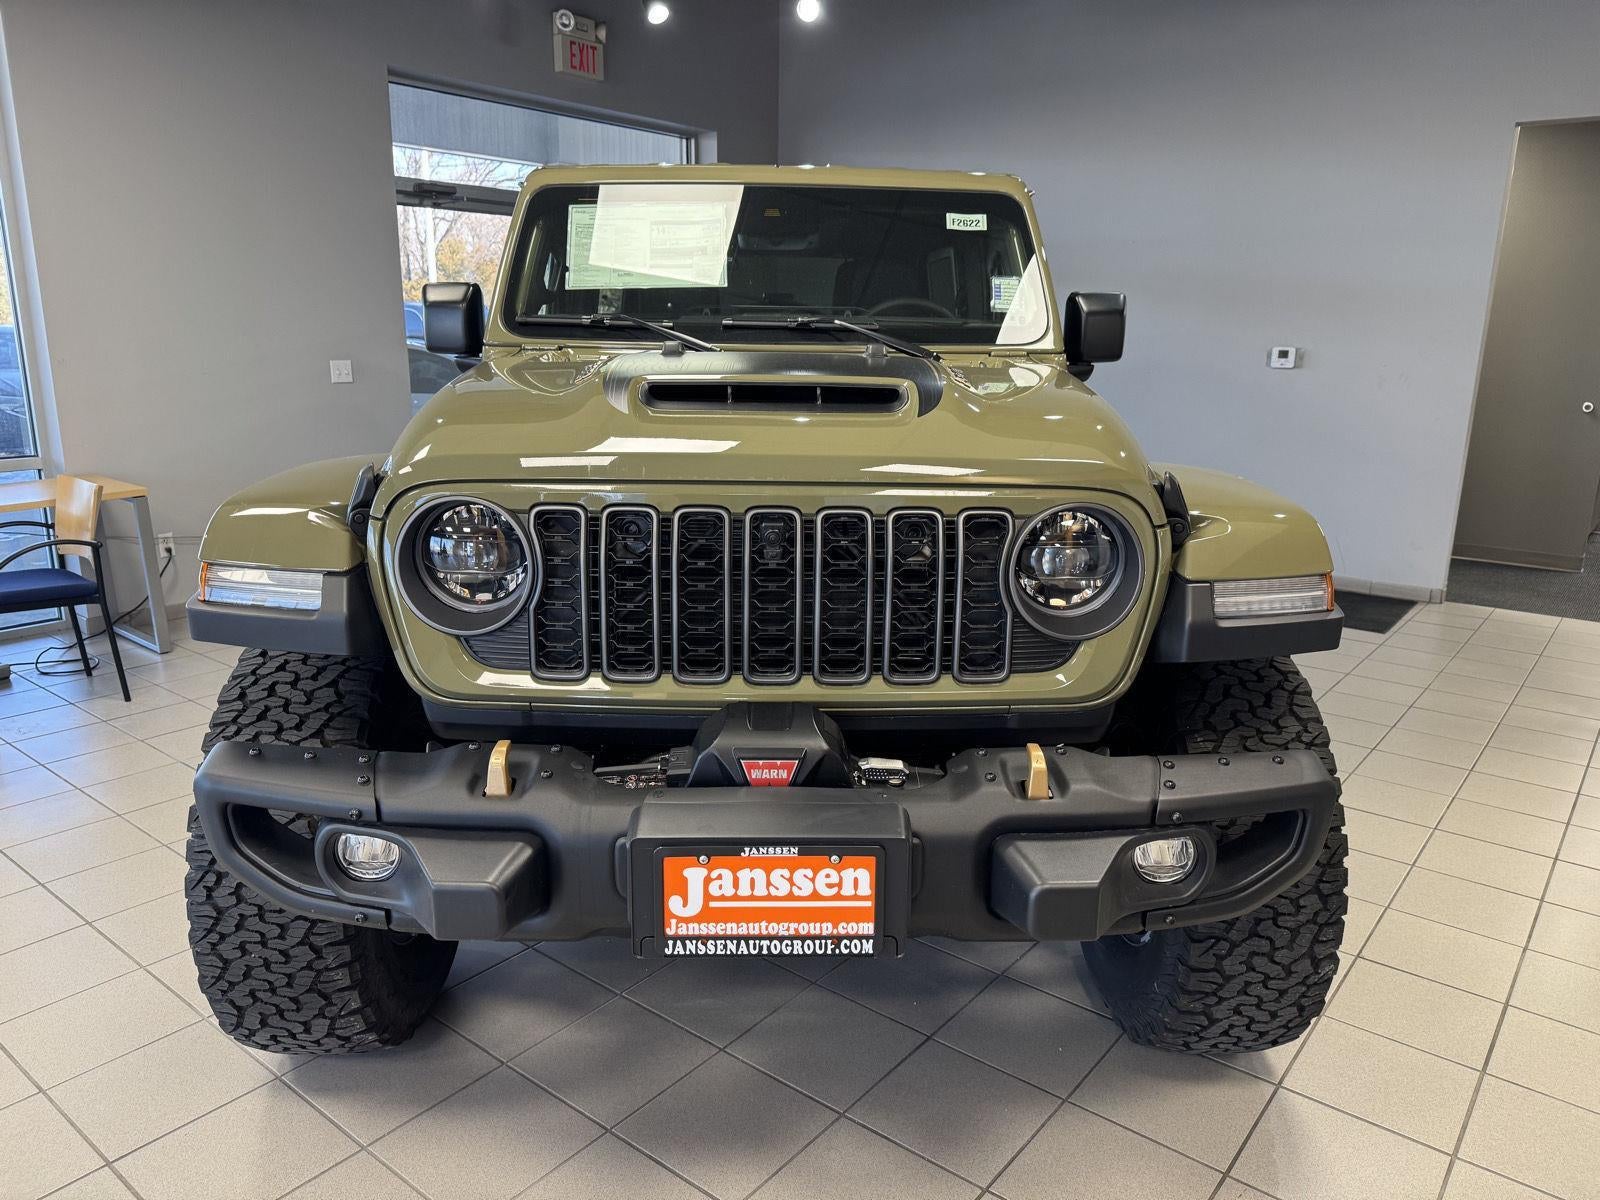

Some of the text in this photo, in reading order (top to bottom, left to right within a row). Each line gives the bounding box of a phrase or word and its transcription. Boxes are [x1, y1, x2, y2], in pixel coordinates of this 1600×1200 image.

[570, 41, 597, 74] EXIT
[952, 218, 980, 228] F2622
[751, 769, 787, 779] WARN
[741, 847, 798, 856] JANSSEN
[668, 867, 872, 917] Janssen
[665, 919, 875, 936] Janssenautogroup.com
